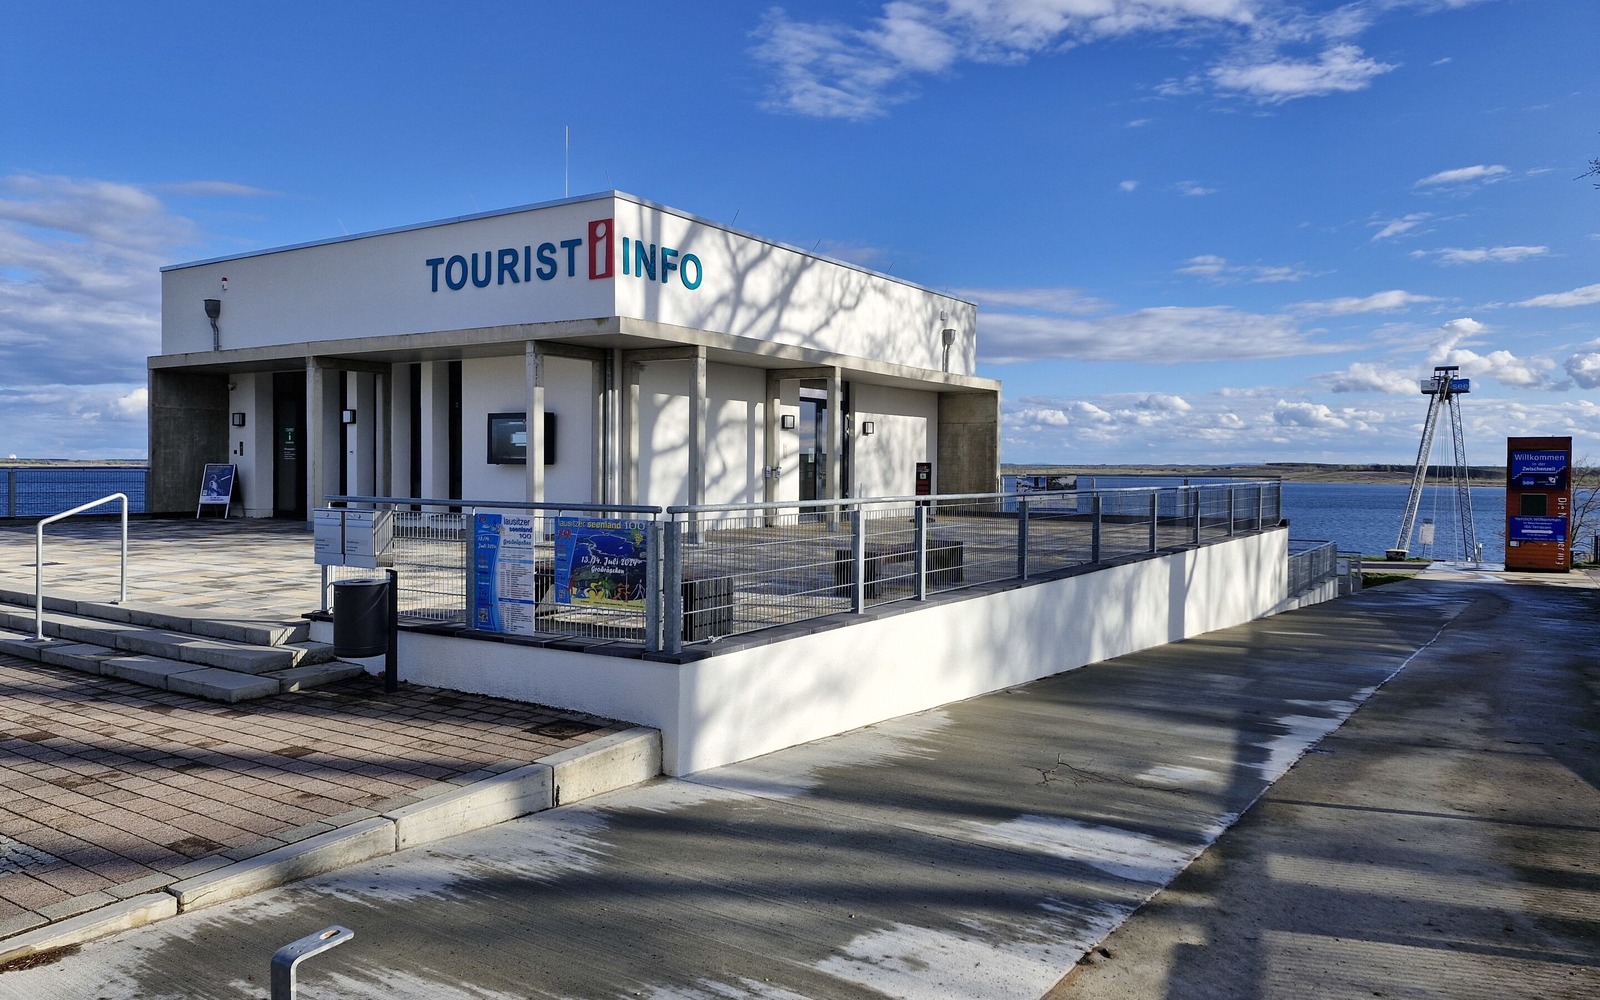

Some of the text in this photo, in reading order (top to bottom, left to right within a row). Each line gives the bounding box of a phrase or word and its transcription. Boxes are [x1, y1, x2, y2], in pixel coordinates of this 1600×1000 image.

[426, 238, 582, 292] TOURIST
[622, 236, 703, 290] INFO
[1514, 453, 1565, 461] Willkommen
[503, 517, 531, 527] lausitzer
[587, 521, 621, 529] seenland
[624, 521, 646, 530] 100
[603, 556, 619, 566] Juli
[620, 558, 637, 567] 2024
